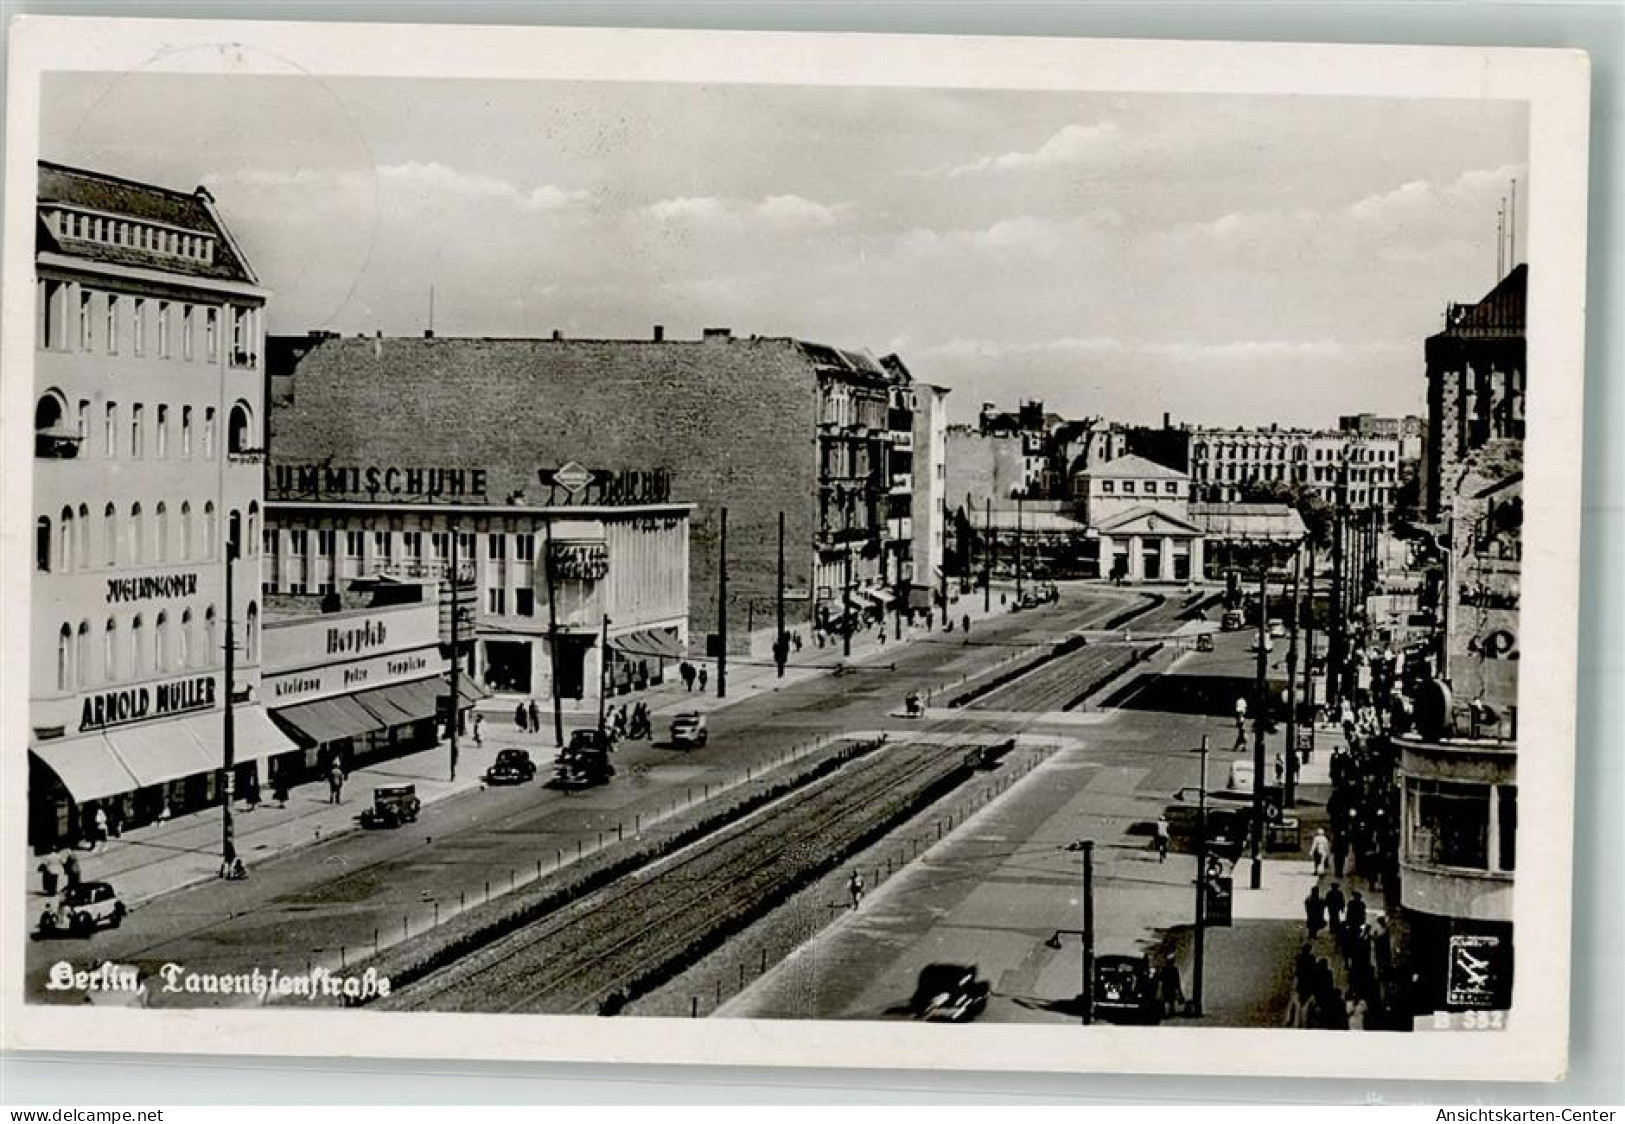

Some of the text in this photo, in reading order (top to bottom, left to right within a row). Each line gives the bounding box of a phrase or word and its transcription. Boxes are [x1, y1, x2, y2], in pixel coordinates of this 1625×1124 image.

[267, 464, 488, 497] UMMISCHUHE
[79, 676, 216, 728] ARNOLD MÜLLER
